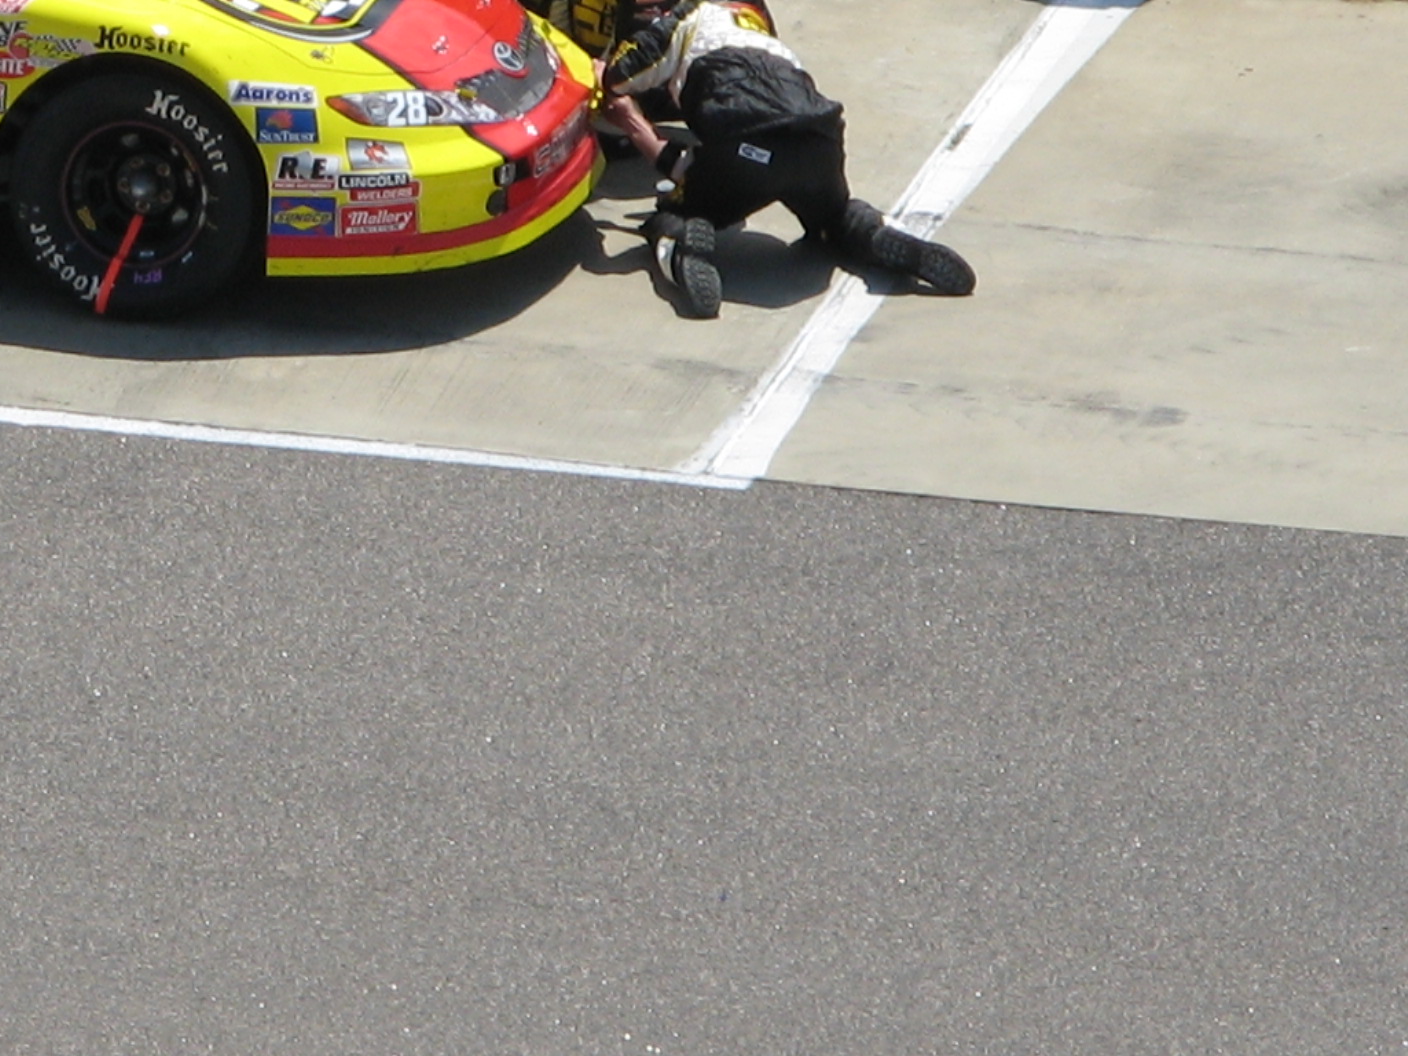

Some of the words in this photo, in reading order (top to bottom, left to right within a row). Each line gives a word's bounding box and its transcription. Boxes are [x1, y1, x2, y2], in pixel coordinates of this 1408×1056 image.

[95, 26, 190, 56] Hoosier
[232, 81, 313, 102] Aaron's
[386, 92, 428, 126] 28
[146, 90, 228, 173] Hoosier
[341, 173, 406, 188] LINCOLN
[358, 187, 413, 201] WELDERS
[274, 212, 332, 224] SUNOCO
[348, 209, 413, 227] Mallory
